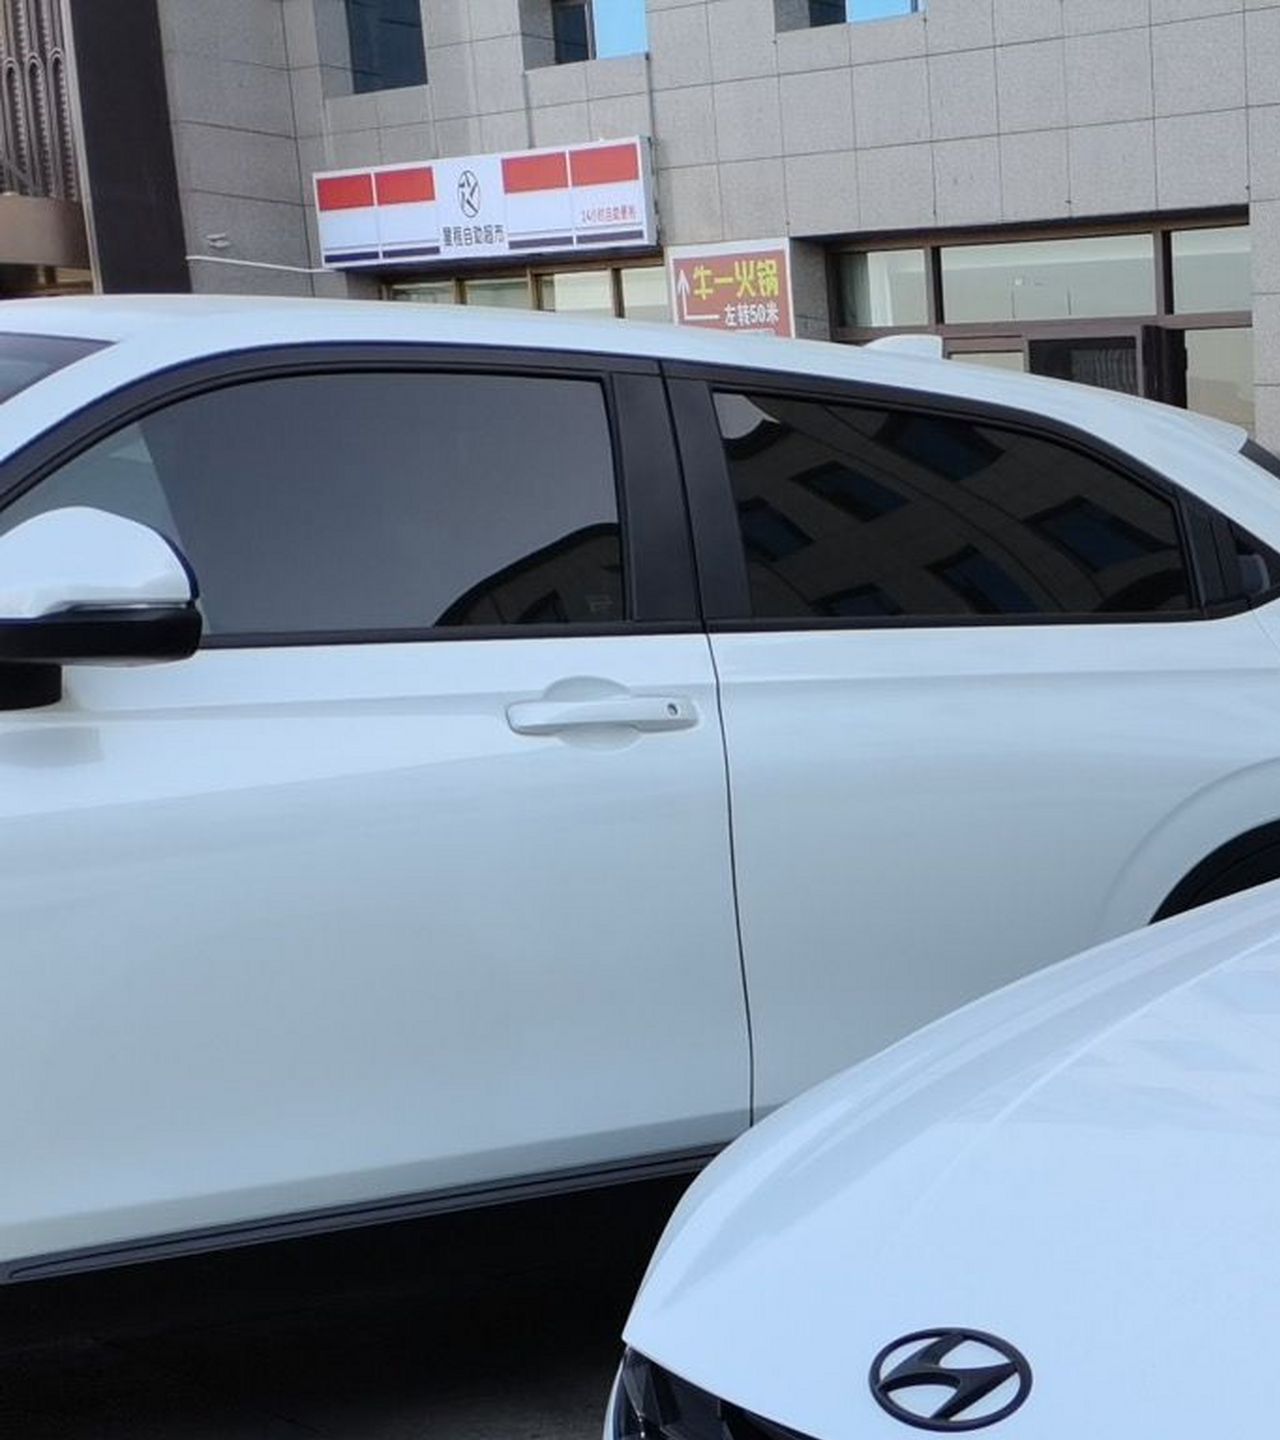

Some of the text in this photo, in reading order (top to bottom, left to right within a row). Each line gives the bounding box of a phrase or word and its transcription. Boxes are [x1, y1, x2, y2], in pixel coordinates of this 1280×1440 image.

[693, 259, 779, 300] 牛一火锅
[724, 301, 779, 327] 左转50米
